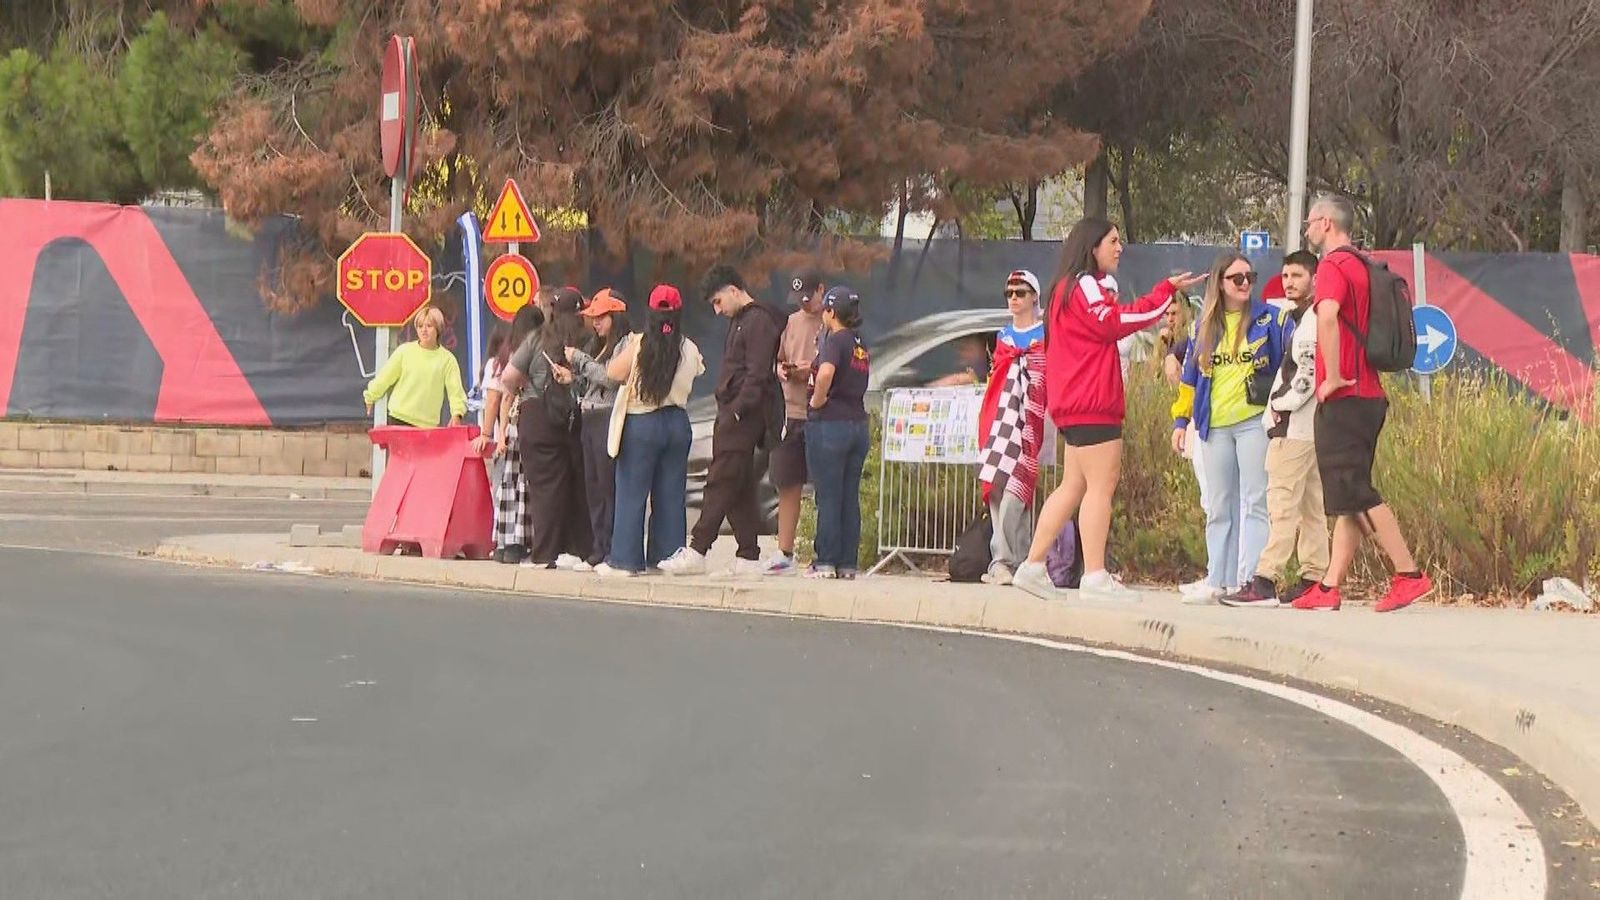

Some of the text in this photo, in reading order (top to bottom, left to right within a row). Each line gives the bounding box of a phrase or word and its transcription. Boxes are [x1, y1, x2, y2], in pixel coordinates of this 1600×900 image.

[1246, 235, 1263, 253] P
[346, 270, 424, 291] STOP
[497, 277, 527, 298] 20
